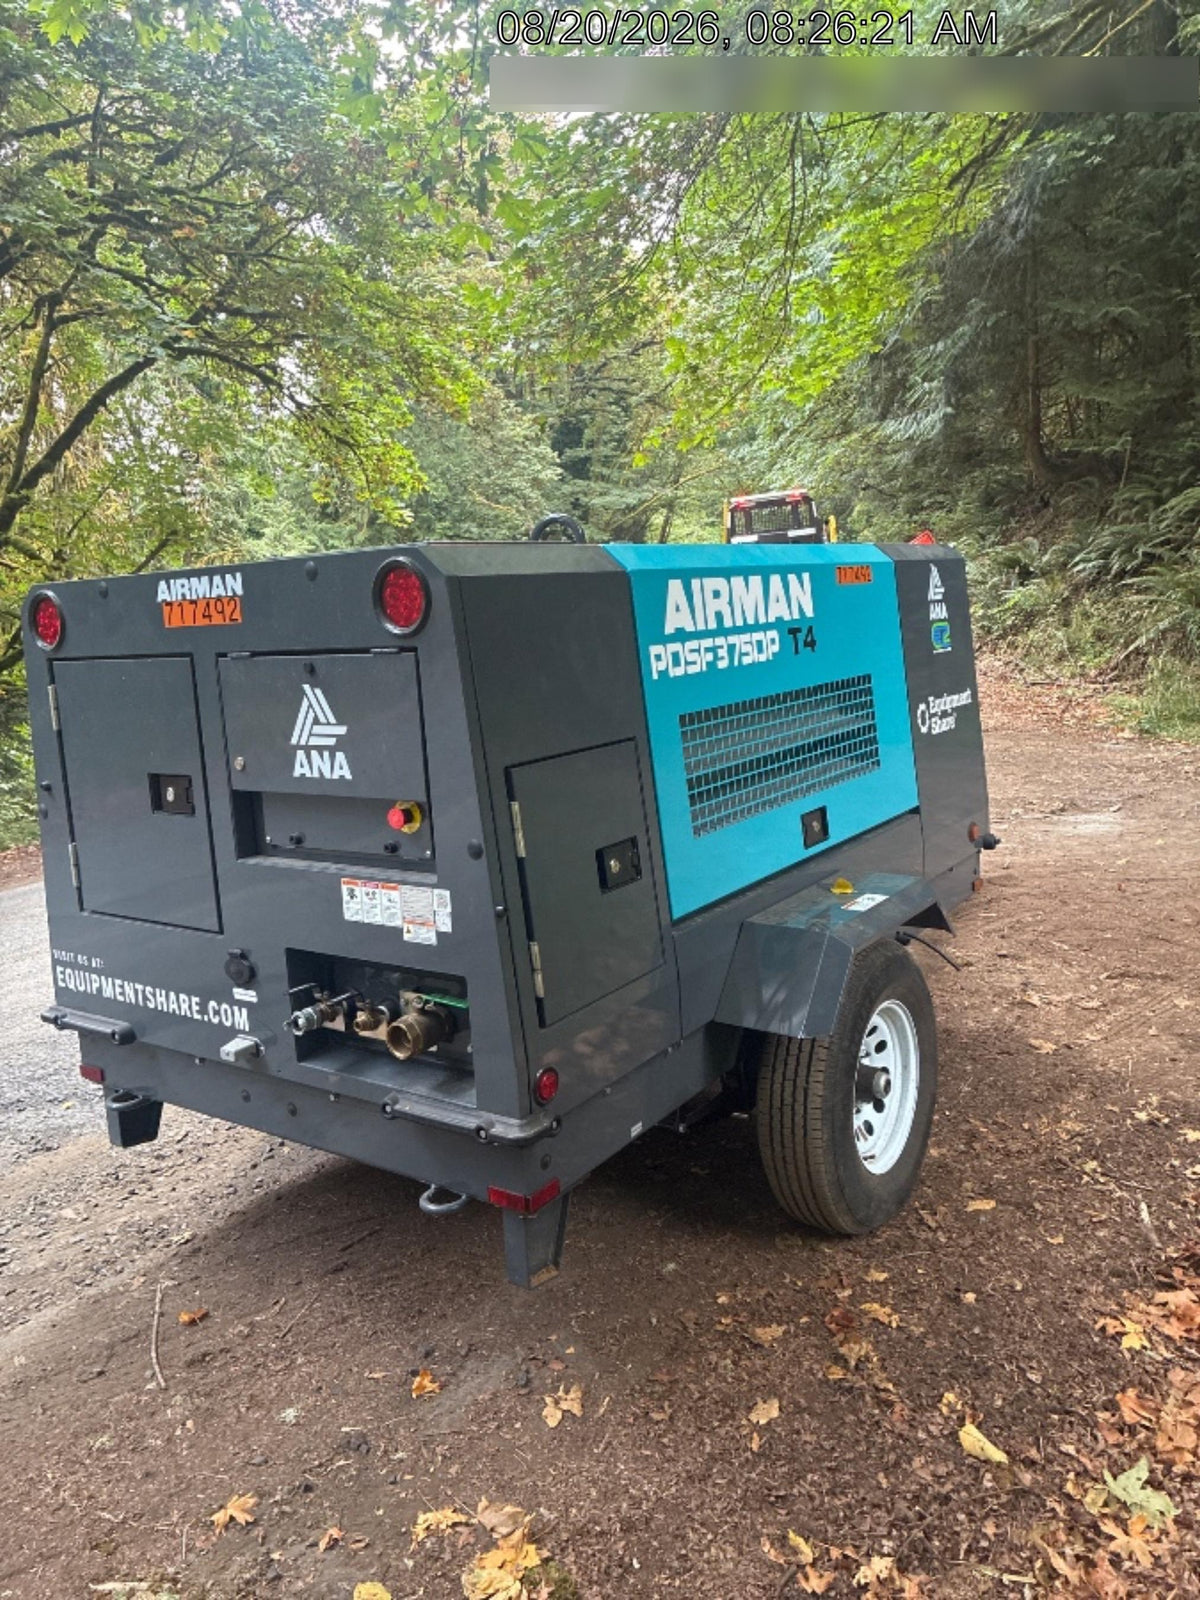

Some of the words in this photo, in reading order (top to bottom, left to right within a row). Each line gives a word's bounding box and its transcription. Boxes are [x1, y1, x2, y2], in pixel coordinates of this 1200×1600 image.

[157, 572, 243, 602] AIRMAN
[164, 598, 239, 625] 717492
[664, 572, 814, 635] AIRMAN
[929, 602, 948, 620] ANA
[649, 629, 780, 680] PDSF375DP
[787, 625, 817, 655] T4
[293, 749, 353, 779] ANA
[56, 965, 249, 1032] EQUIPMENTSHARE.COM
